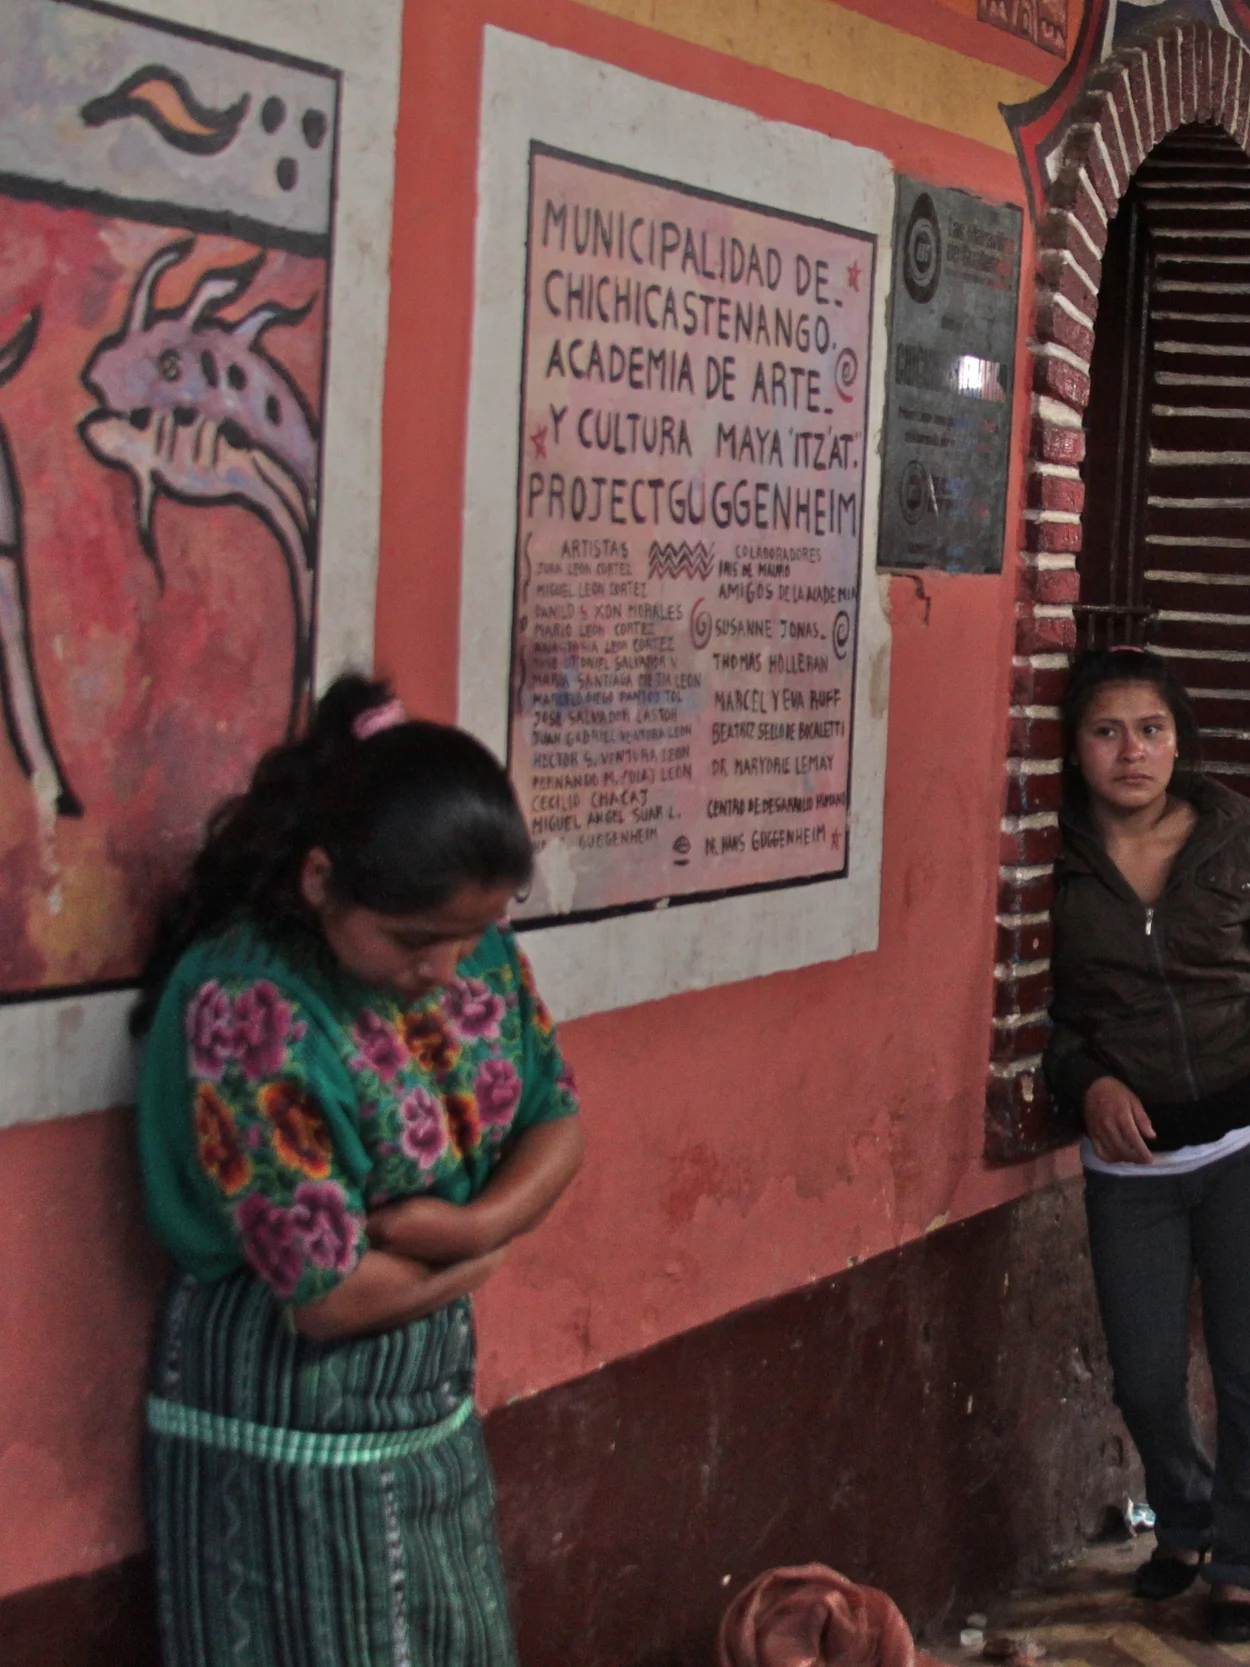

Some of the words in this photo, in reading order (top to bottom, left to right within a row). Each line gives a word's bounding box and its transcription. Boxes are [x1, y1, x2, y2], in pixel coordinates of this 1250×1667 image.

[541, 198, 782, 291] MUNICIPALIDAD
[545, 338, 695, 395] ACADEMIA
[706, 355, 736, 401] DE
[550, 403, 568, 444] Y
[578, 407, 692, 457] CULTURA
[716, 421, 783, 467] MAYA
[561, 539, 629, 559] ARTISTAS
[734, 544, 822, 563] COLABORADORES
[536, 562, 562, 576] JUAN
[596, 561, 632, 577] CORTEZ
[758, 562, 791, 578] MAURO
[536, 583, 574, 598] MIGUEL
[579, 582, 604, 599] LEON
[609, 580, 647, 599] CORTEZ
[718, 582, 774, 604] AMIGOS
[806, 584, 857, 604] ACADEMIA
[535, 603, 575, 620] DANILO
[595, 602, 622, 620] XON
[628, 603, 683, 621] MORALES
[614, 621, 655, 637] CORTEZ
[715, 617, 772, 639] SUSANNE
[633, 636, 675, 652] CORTEZ
[713, 651, 762, 673] THOMAS
[715, 688, 767, 714] MARCEL
[772, 689, 780, 713] Y
[782, 688, 804, 712] EVA
[667, 724, 692, 739] LEON
[712, 721, 755, 745] BEATRIZ
[533, 751, 578, 769] HECTOR
[662, 744, 690, 763] LEON
[795, 754, 834, 775] LEMAY
[660, 763, 692, 782] LEON
[531, 792, 580, 812] CECILIO
[591, 787, 648, 807] CHACAJ
[707, 797, 745, 819] CENTRO
[532, 815, 581, 835] MIGUEL
[587, 808, 624, 826] ANGEL
[752, 824, 826, 852] GUGGENHEIM
